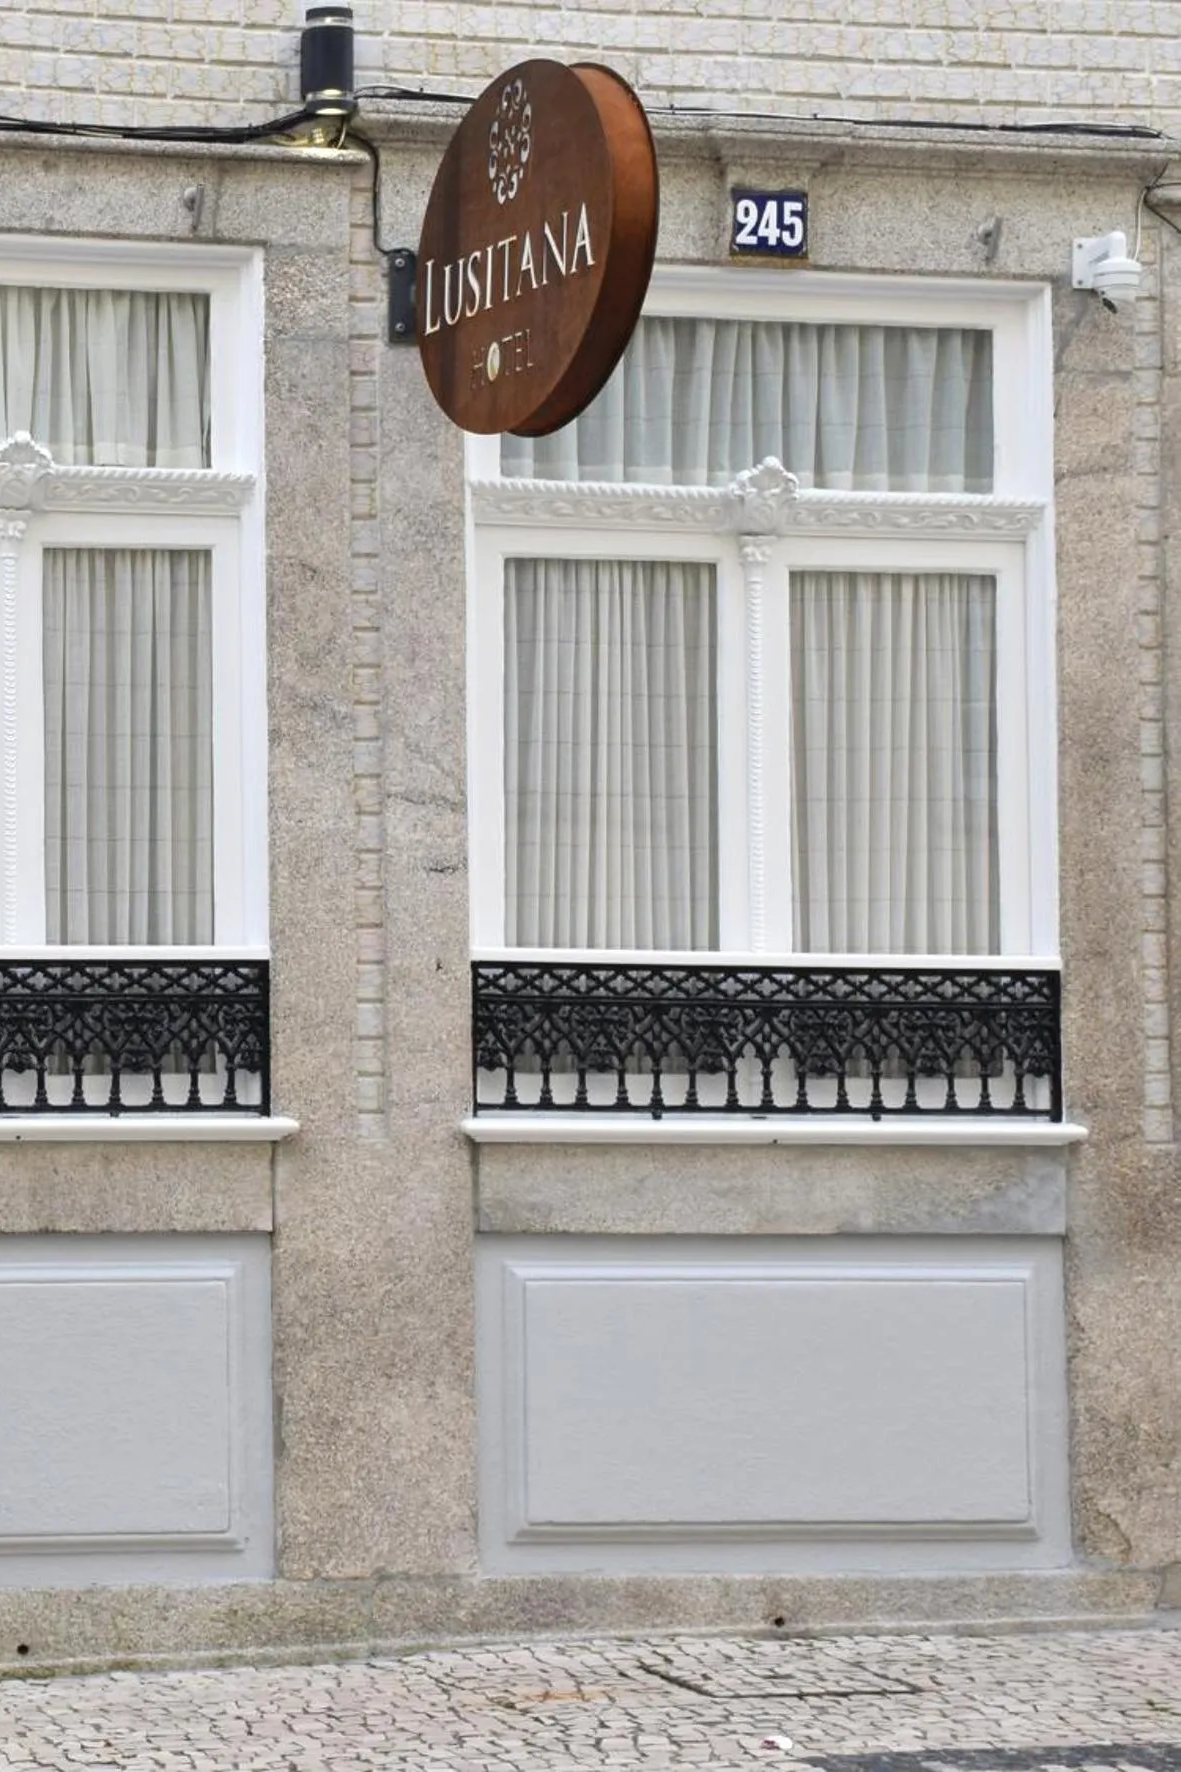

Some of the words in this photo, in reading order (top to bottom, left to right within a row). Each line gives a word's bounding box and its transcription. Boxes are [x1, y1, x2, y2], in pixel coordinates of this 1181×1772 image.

[735, 199, 805, 248] 245
[424, 203, 595, 336] LUSITANA
[469, 328, 534, 389] HOTEL
